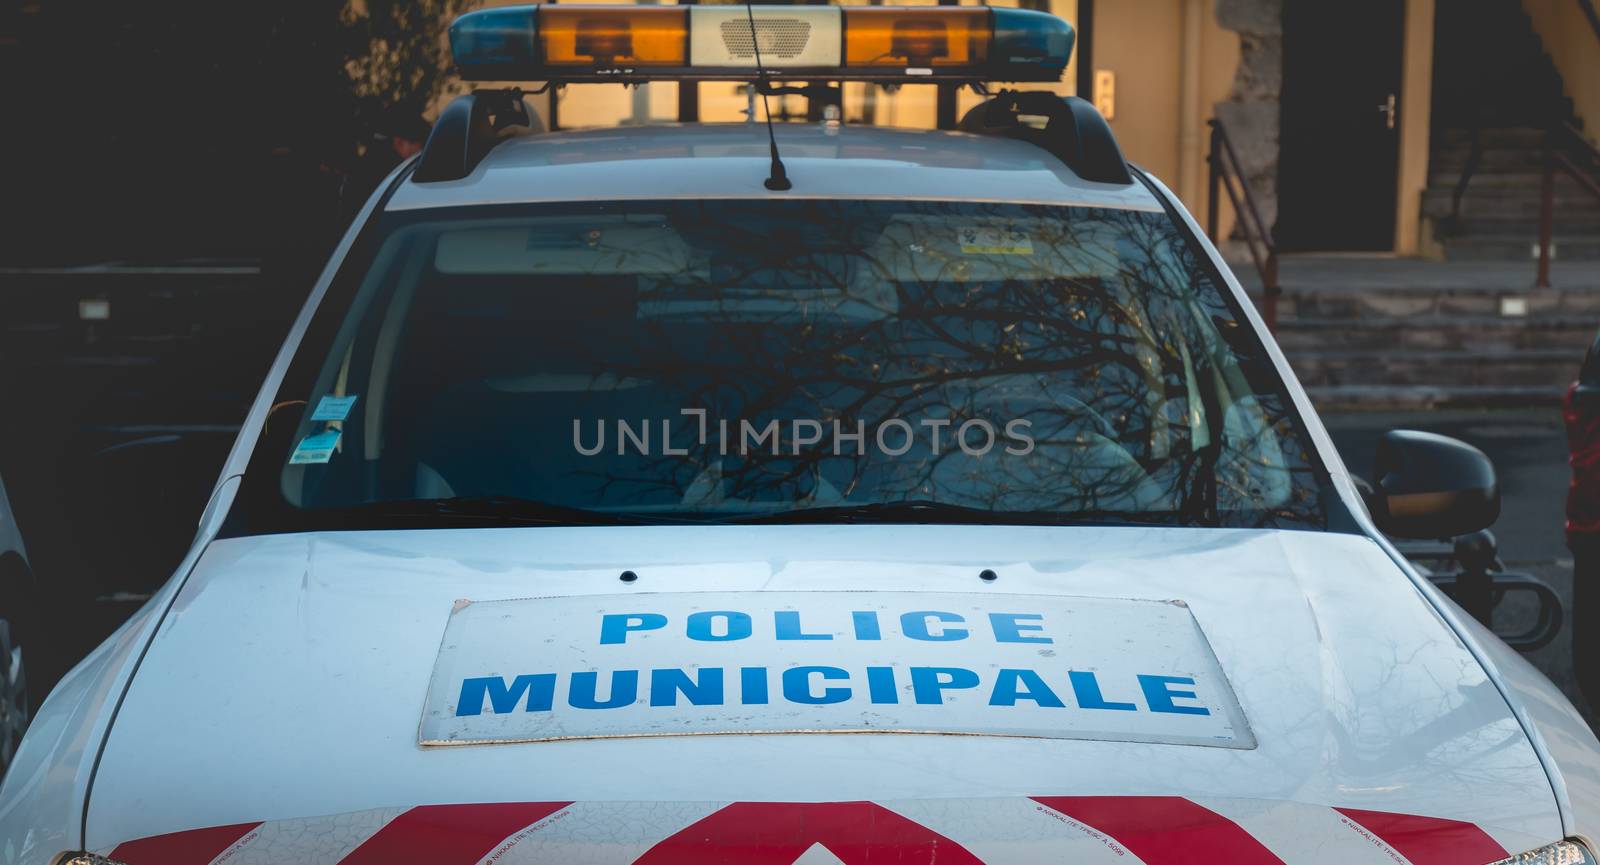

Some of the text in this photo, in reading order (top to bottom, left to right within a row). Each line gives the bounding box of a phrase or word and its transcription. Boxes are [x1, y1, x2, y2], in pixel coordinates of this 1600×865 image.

[599, 610, 1054, 646] POLICE
[455, 665, 1212, 717] MUNICIPALE
[1043, 809, 1078, 827] NIKKALITE
[1108, 843, 1125, 856] 5099
[1347, 822, 1384, 848] NIKKALITE
